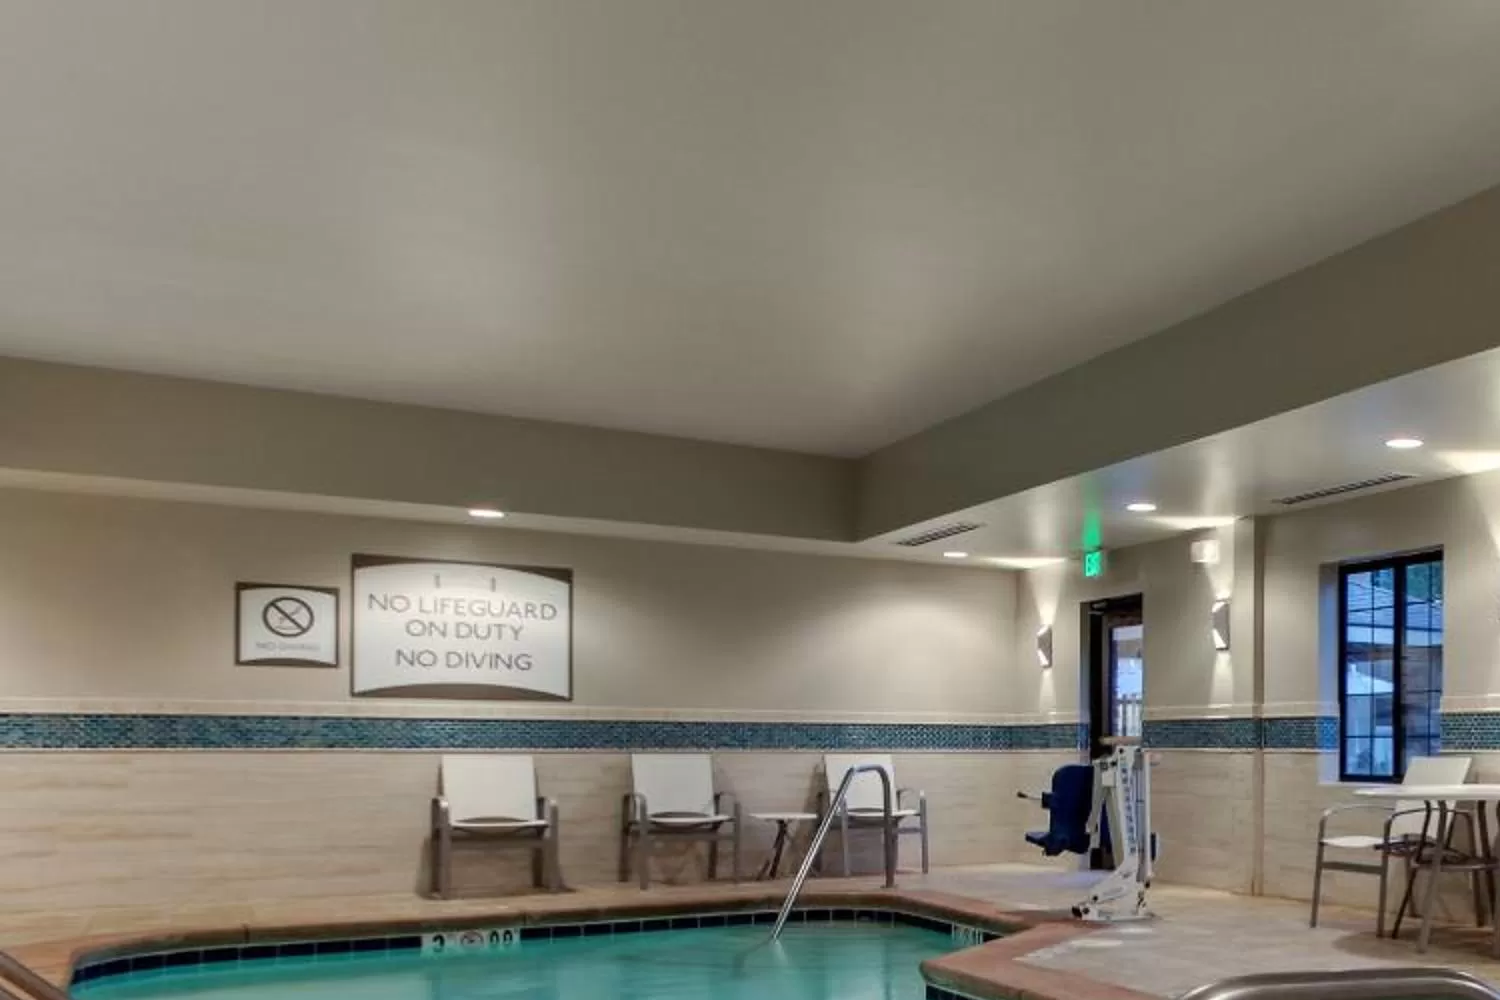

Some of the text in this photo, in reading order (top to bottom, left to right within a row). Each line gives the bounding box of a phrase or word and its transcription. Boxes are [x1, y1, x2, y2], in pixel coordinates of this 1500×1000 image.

[367, 593, 557, 621] NO LIFEGUARD
[405, 619, 524, 641] ON DUTY
[395, 649, 533, 671] NO DIVING
